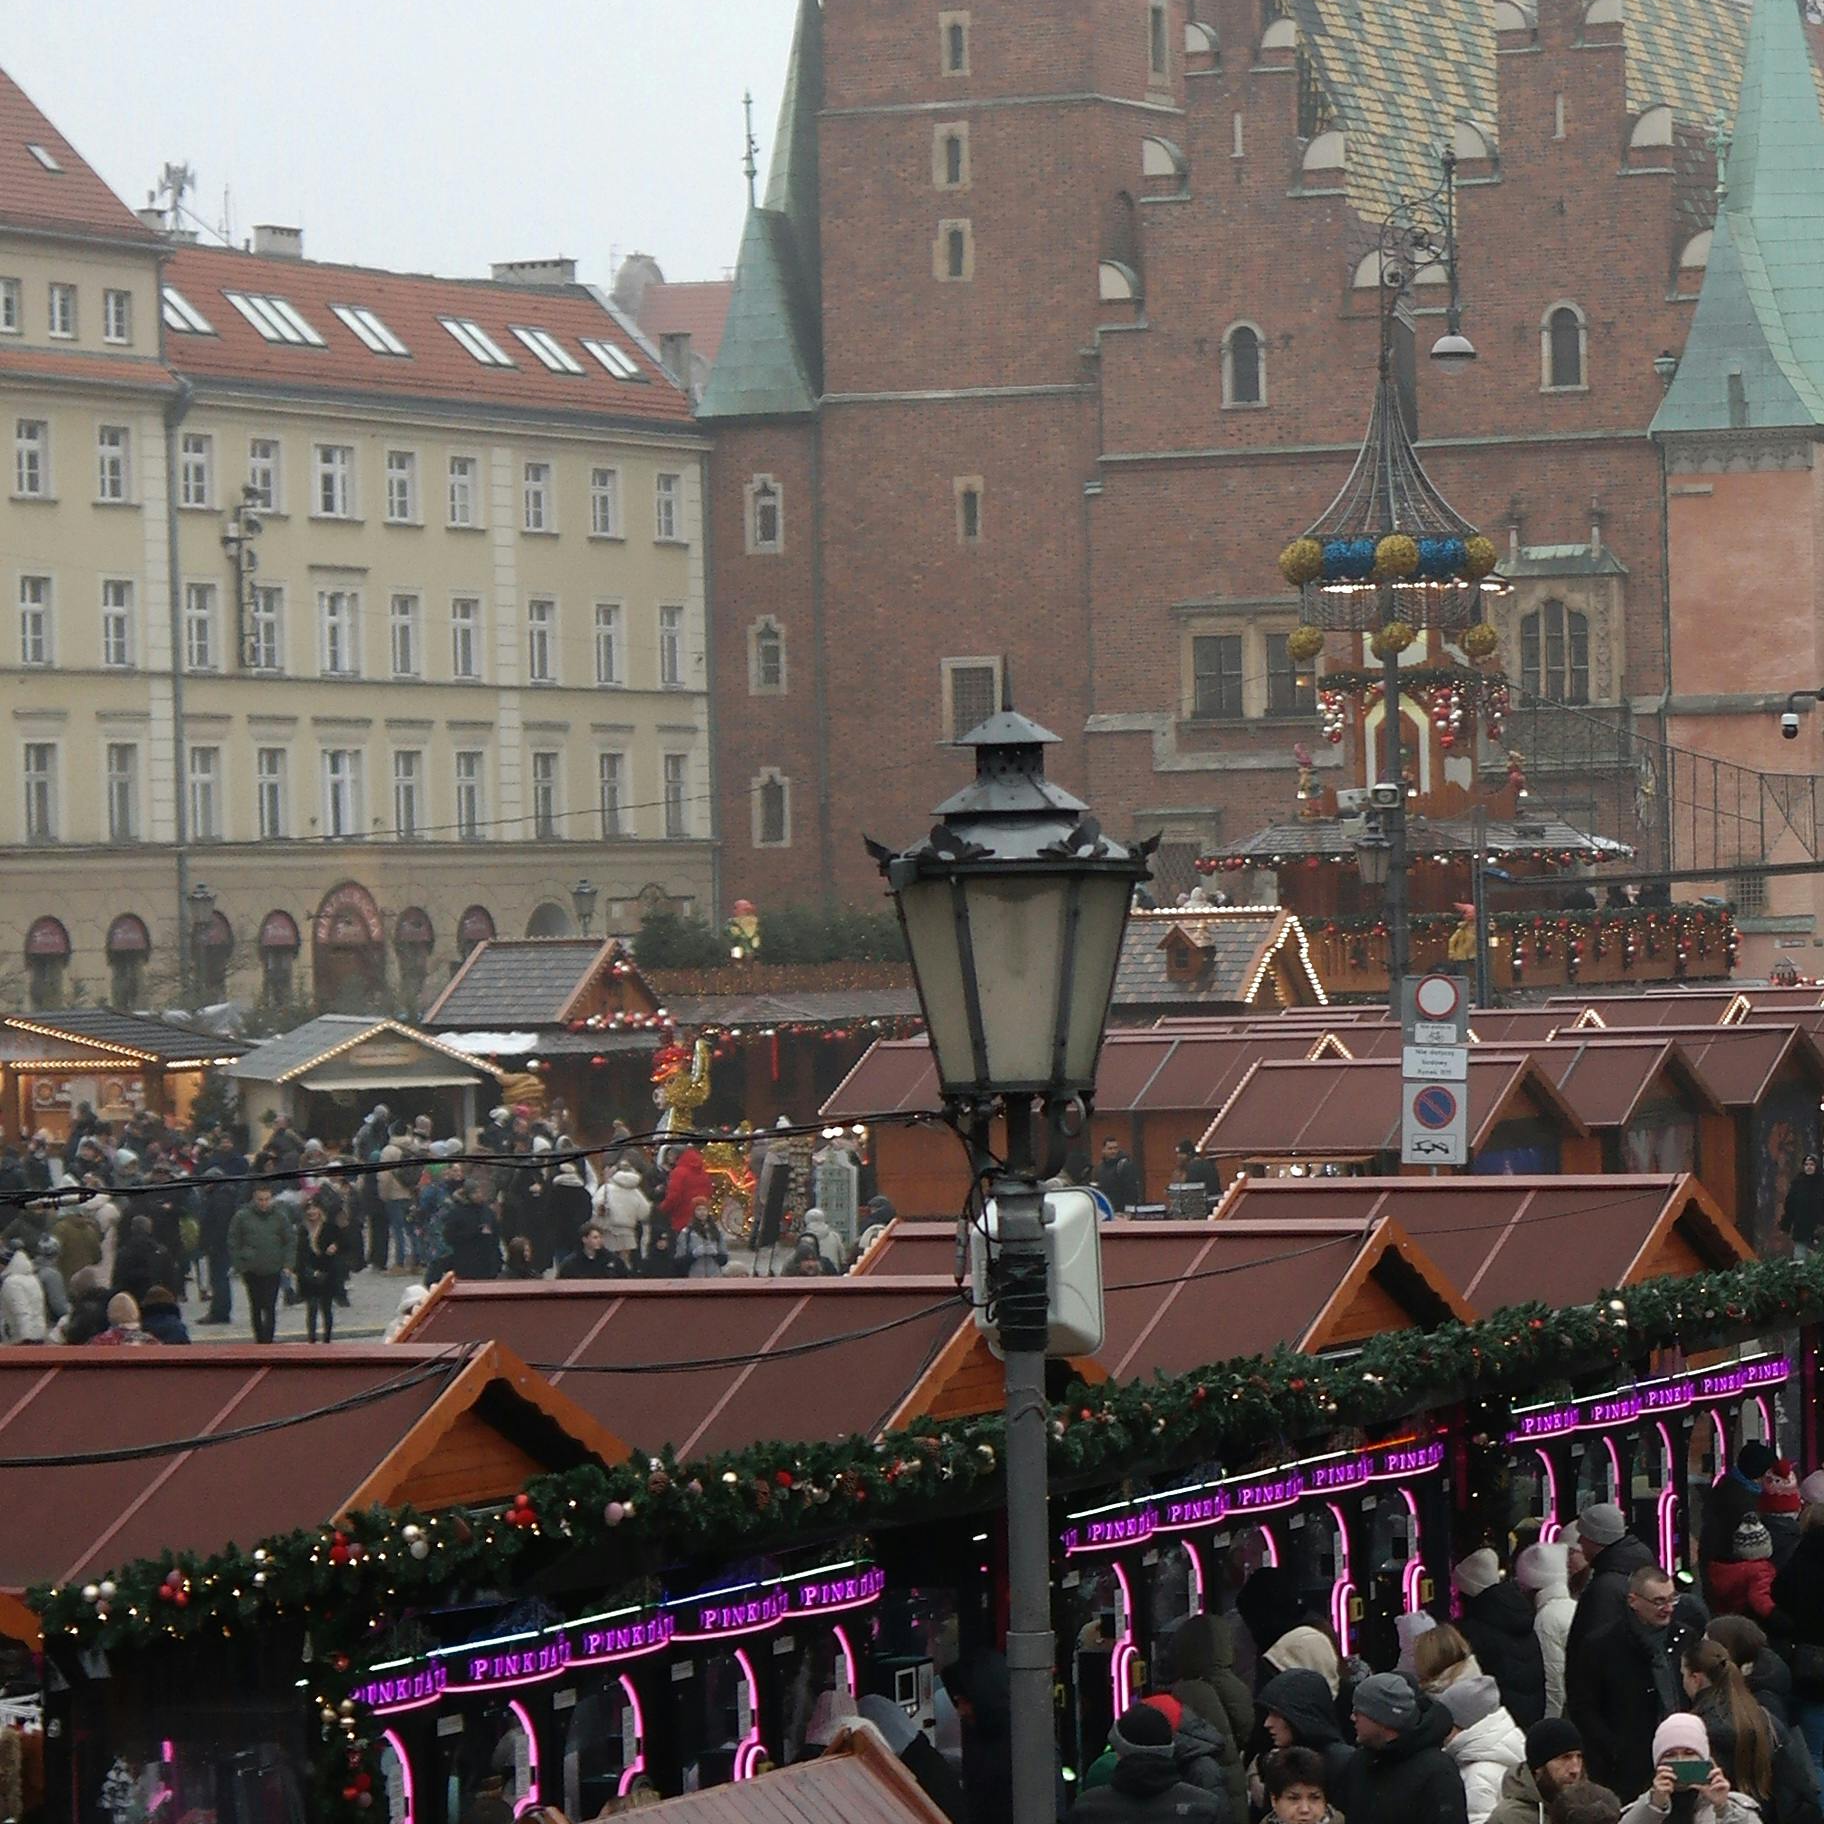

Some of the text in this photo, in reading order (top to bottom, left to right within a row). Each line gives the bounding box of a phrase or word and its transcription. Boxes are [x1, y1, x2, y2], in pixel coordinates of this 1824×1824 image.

[804, 1579, 857, 1606] PINK
[704, 1602, 758, 1629] PINK
[588, 1626, 644, 1655] PINK
[474, 1652, 534, 1680] PINK
